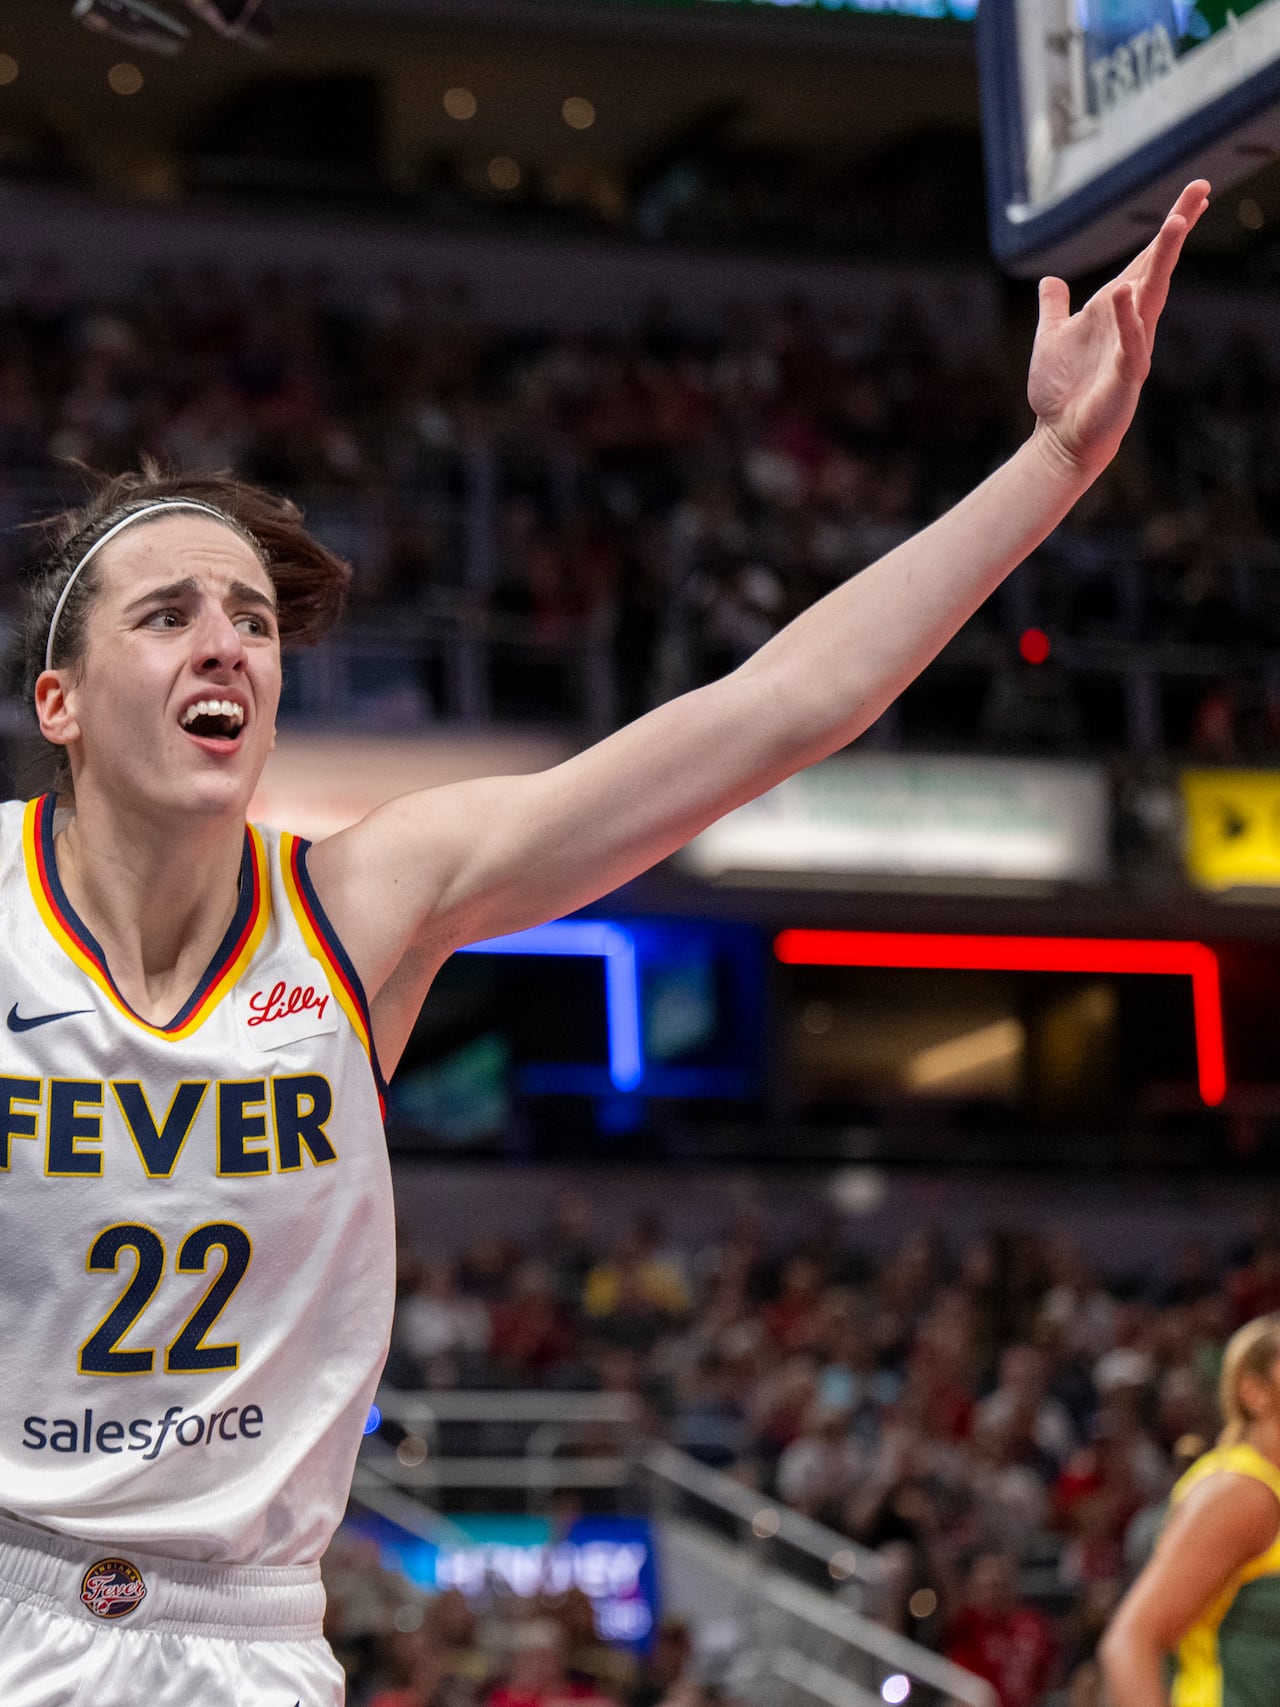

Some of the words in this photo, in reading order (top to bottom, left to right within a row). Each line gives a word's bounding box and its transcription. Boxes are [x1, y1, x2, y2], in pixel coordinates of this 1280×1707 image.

[247, 981, 329, 1027] Lilly
[77, 1220, 254, 1376] 22
[22, 1404, 263, 1460] salesforce
[81, 1573, 146, 1603] Fever
